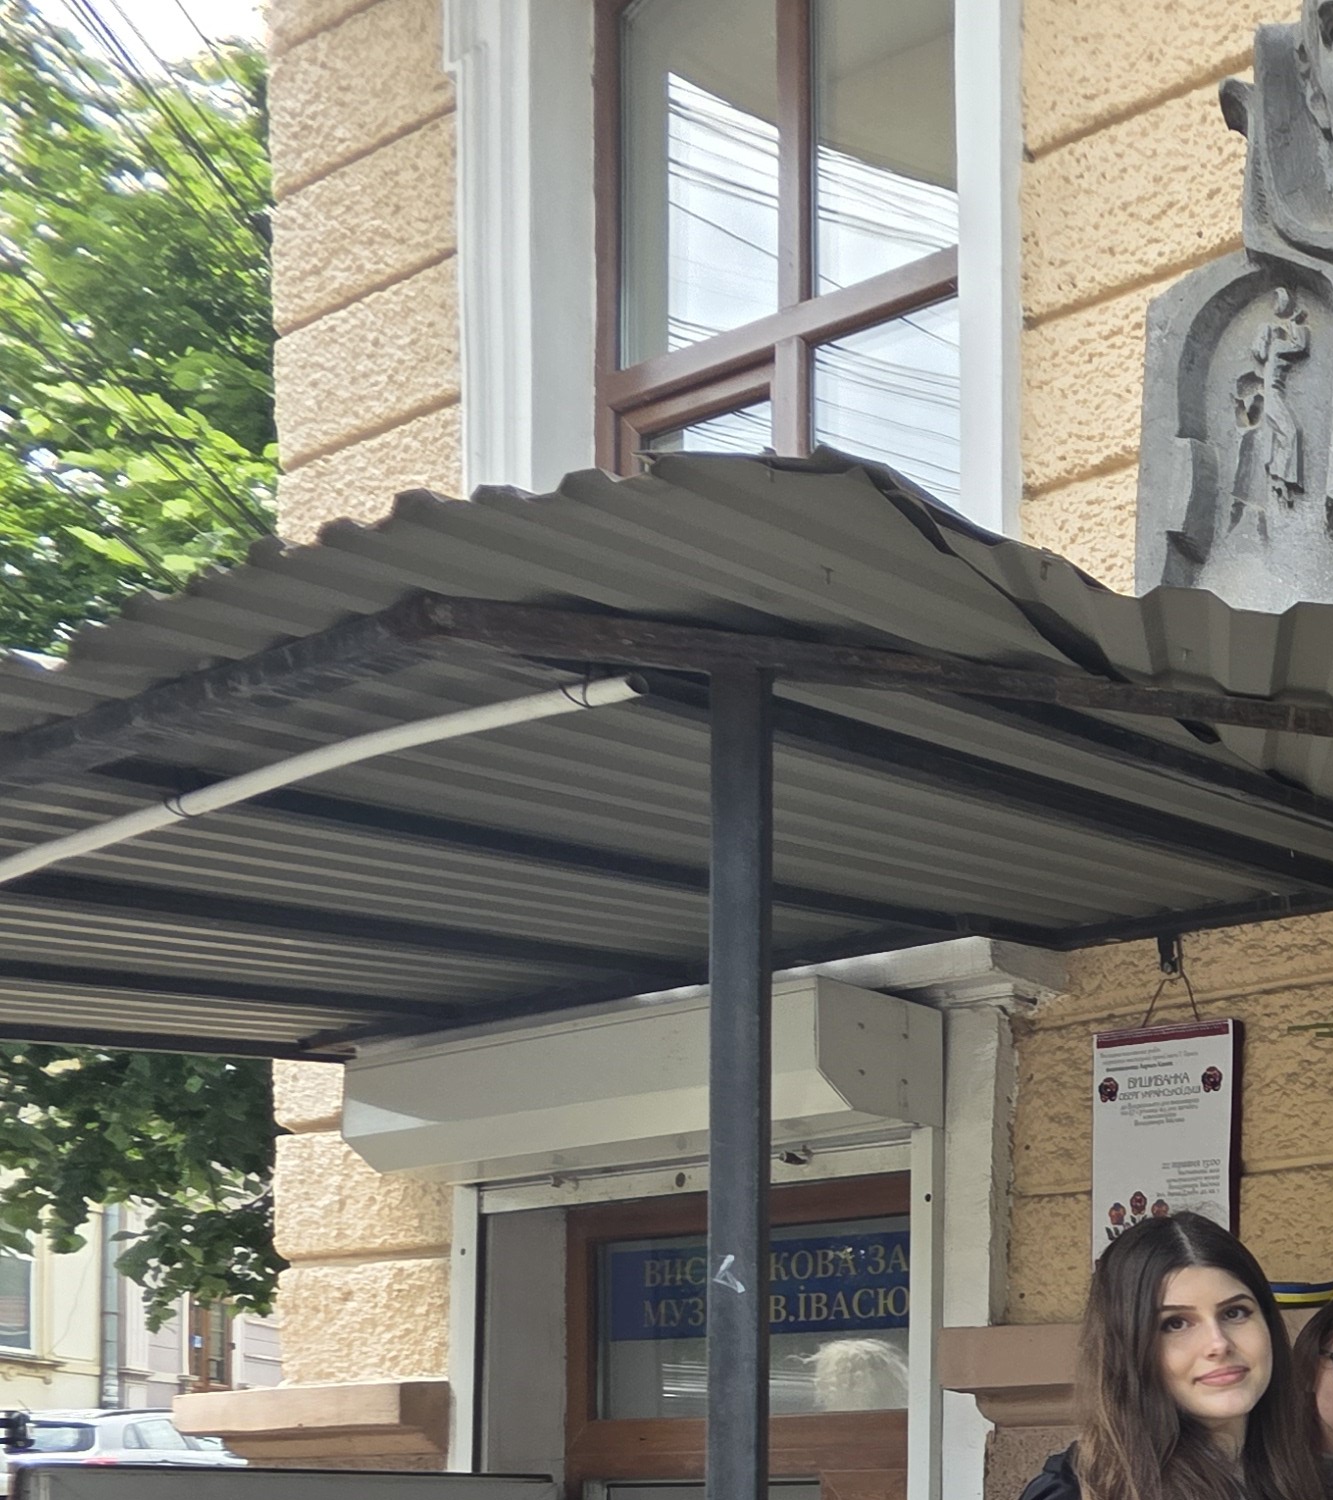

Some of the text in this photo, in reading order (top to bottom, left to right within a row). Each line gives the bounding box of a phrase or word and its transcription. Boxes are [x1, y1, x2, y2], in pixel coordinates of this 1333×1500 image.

[643, 1244, 910, 1287] ВИСКОВА ЗА
[769, 1285, 910, 1323] В.ІВАСЮ
